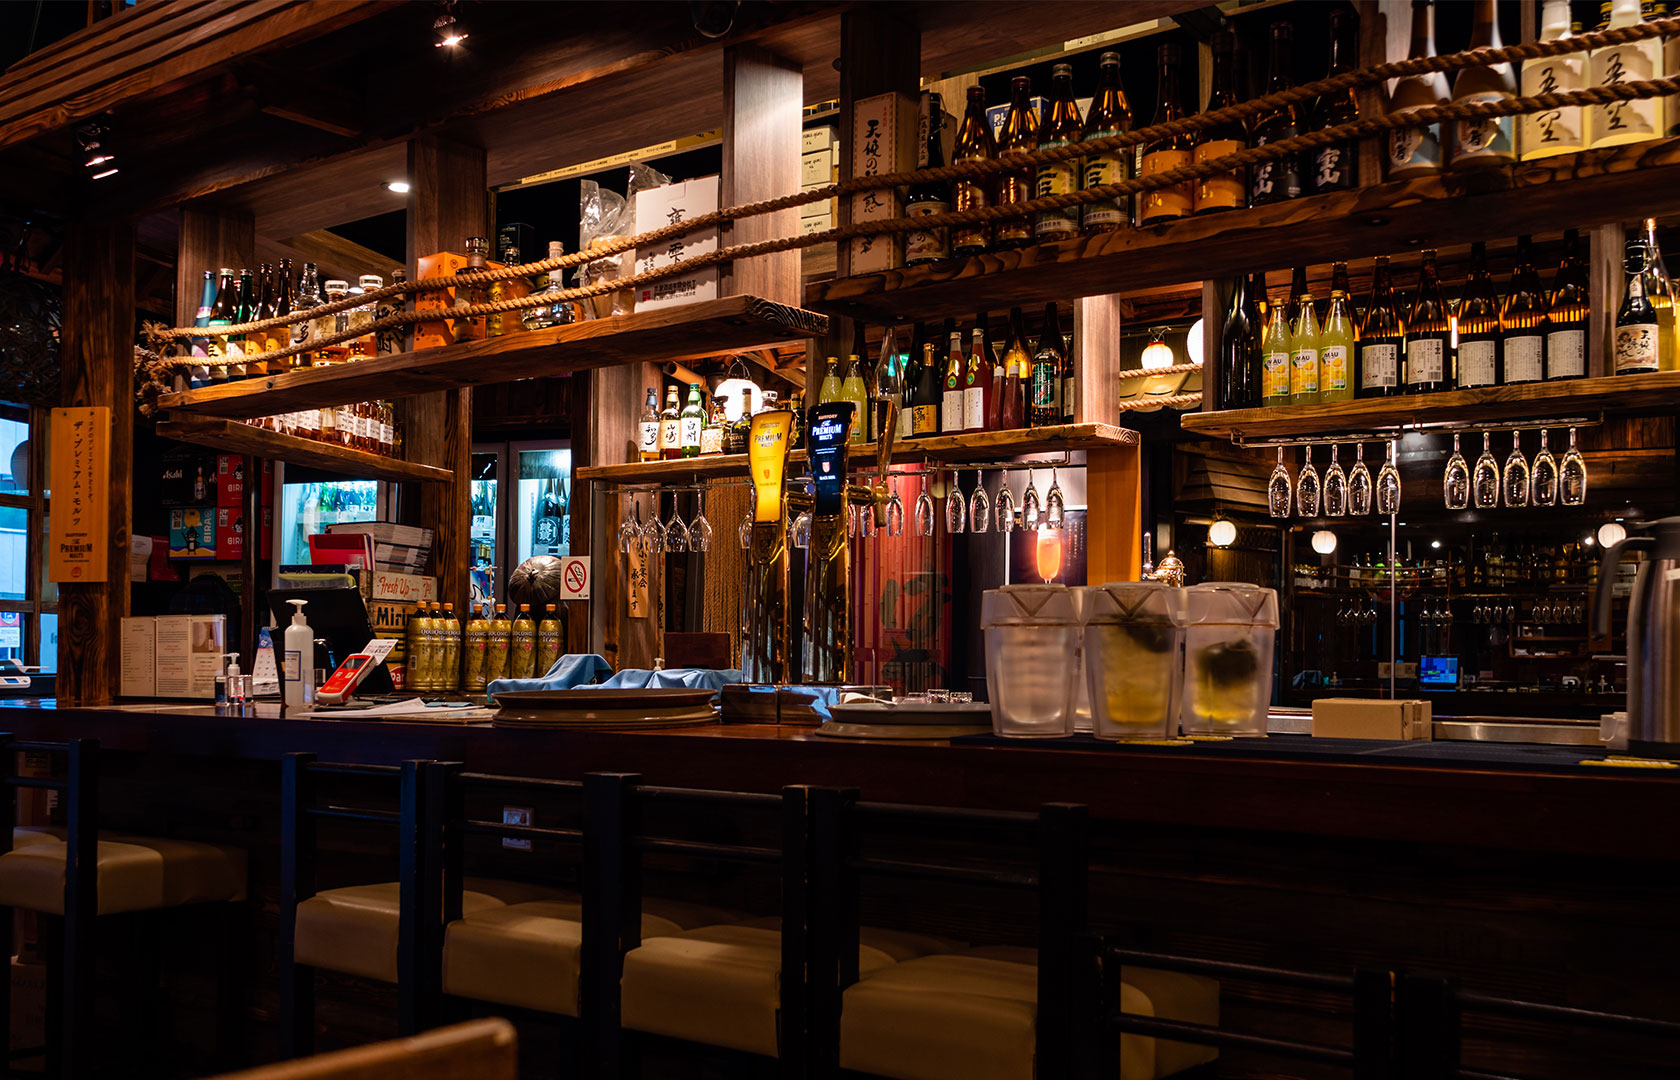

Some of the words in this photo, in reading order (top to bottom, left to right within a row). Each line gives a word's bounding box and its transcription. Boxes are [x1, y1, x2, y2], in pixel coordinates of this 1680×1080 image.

[811, 423, 842, 436] PREMIUM
[754, 432, 782, 444] PREMIUM
[60, 543, 93, 553] PREMIUM
[378, 576, 398, 596] Fresh
[400, 578, 410, 598] Up
